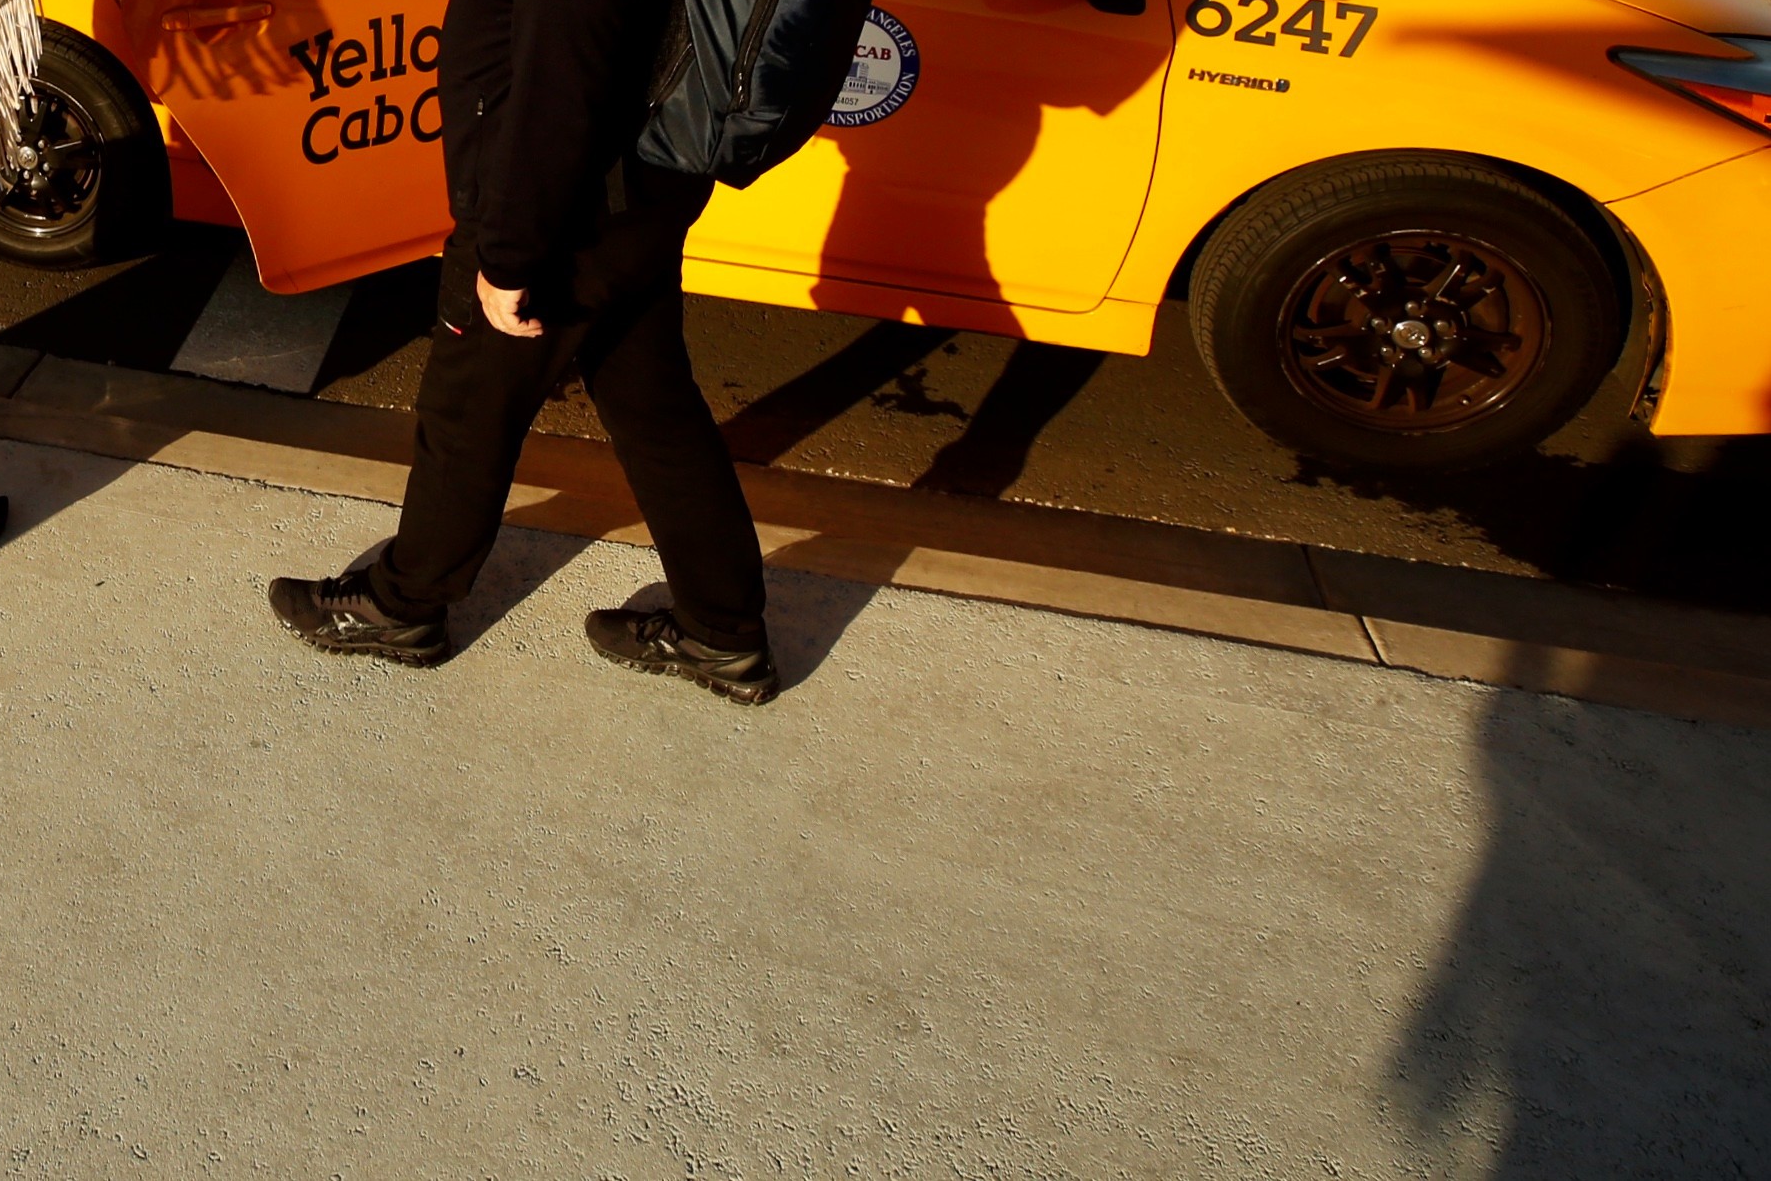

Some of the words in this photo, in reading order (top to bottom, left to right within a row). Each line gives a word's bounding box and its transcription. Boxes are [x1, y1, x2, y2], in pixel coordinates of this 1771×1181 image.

[288, 13, 442, 102] Yello
[866, 8, 916, 58] ANGELES
[824, 71, 916, 126] ANSPORTATION
[1188, 68, 1274, 92] HYBRID
